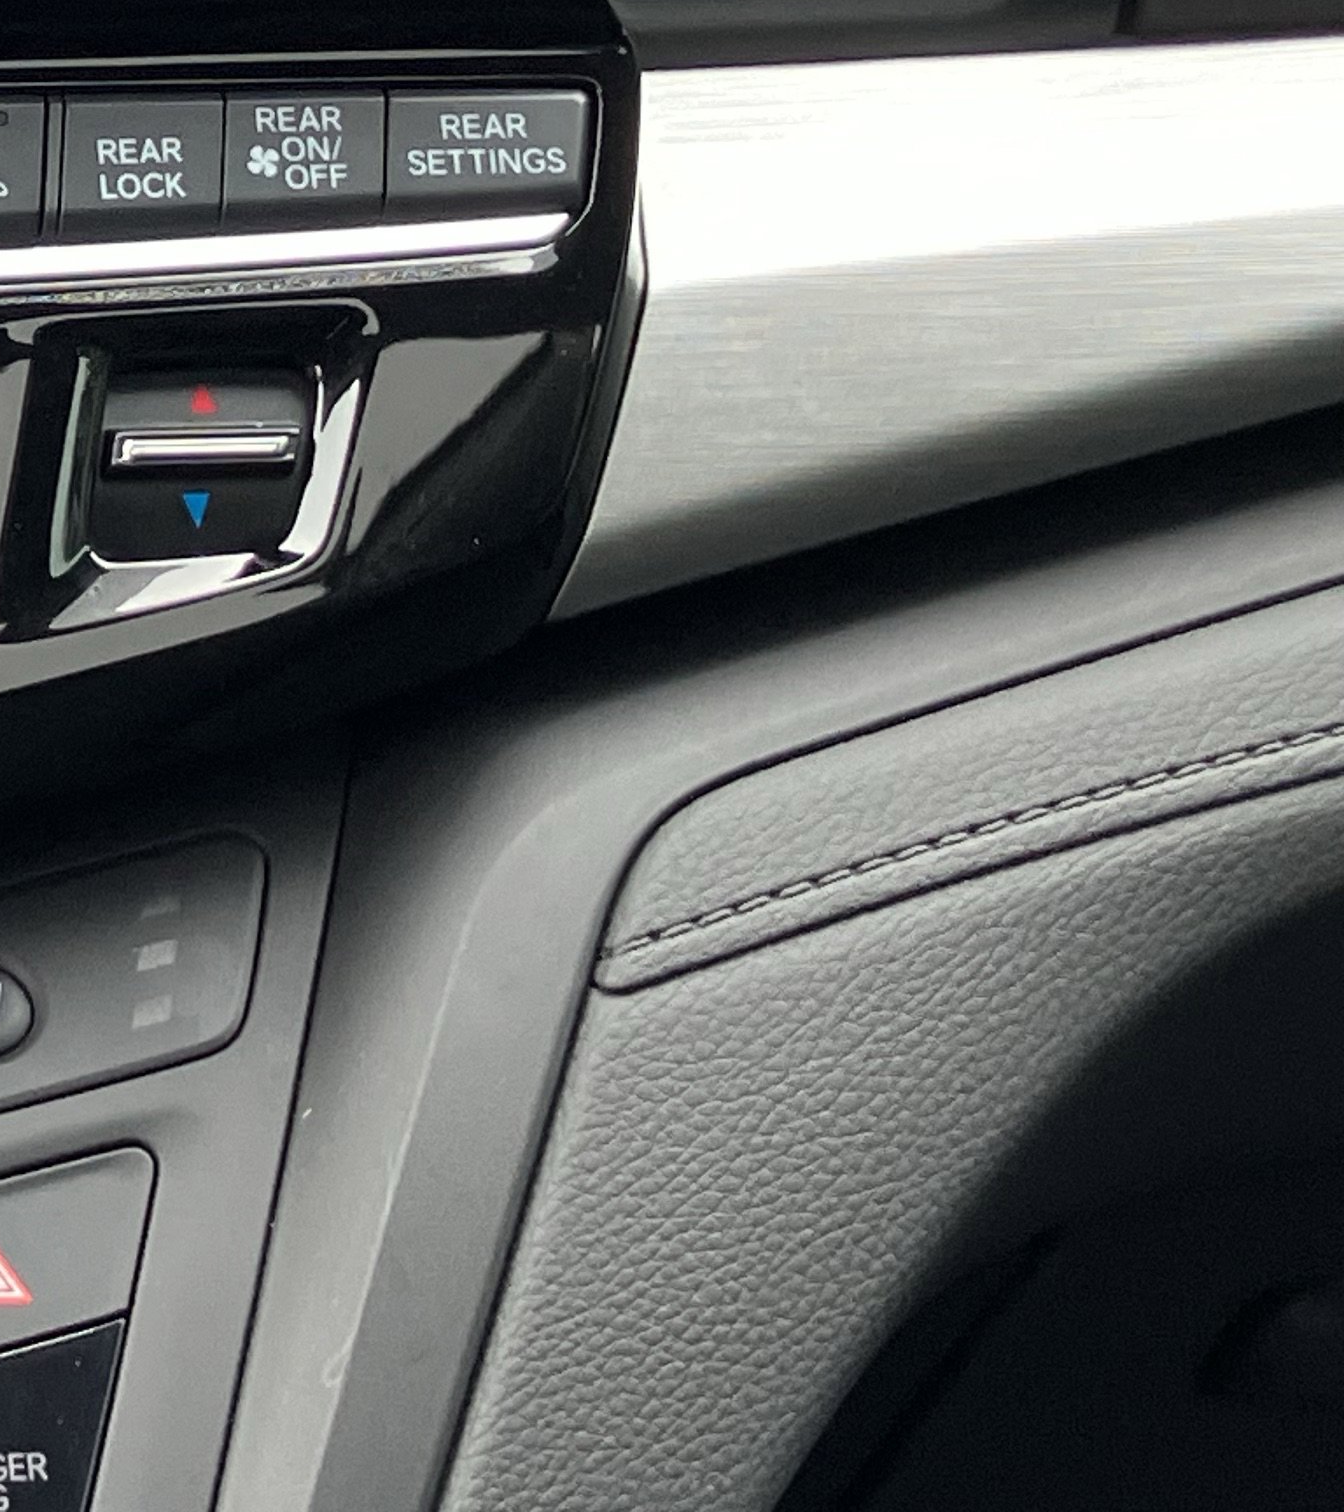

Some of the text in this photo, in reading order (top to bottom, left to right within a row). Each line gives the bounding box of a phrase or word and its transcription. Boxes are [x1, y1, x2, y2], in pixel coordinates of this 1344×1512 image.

[255, 106, 343, 133] REAR
[440, 113, 528, 140] REAR
[96, 137, 184, 165] REAR
[407, 146, 567, 176] SETTINGS
[99, 171, 187, 200] LOCK
[284, 163, 348, 190] OFF
